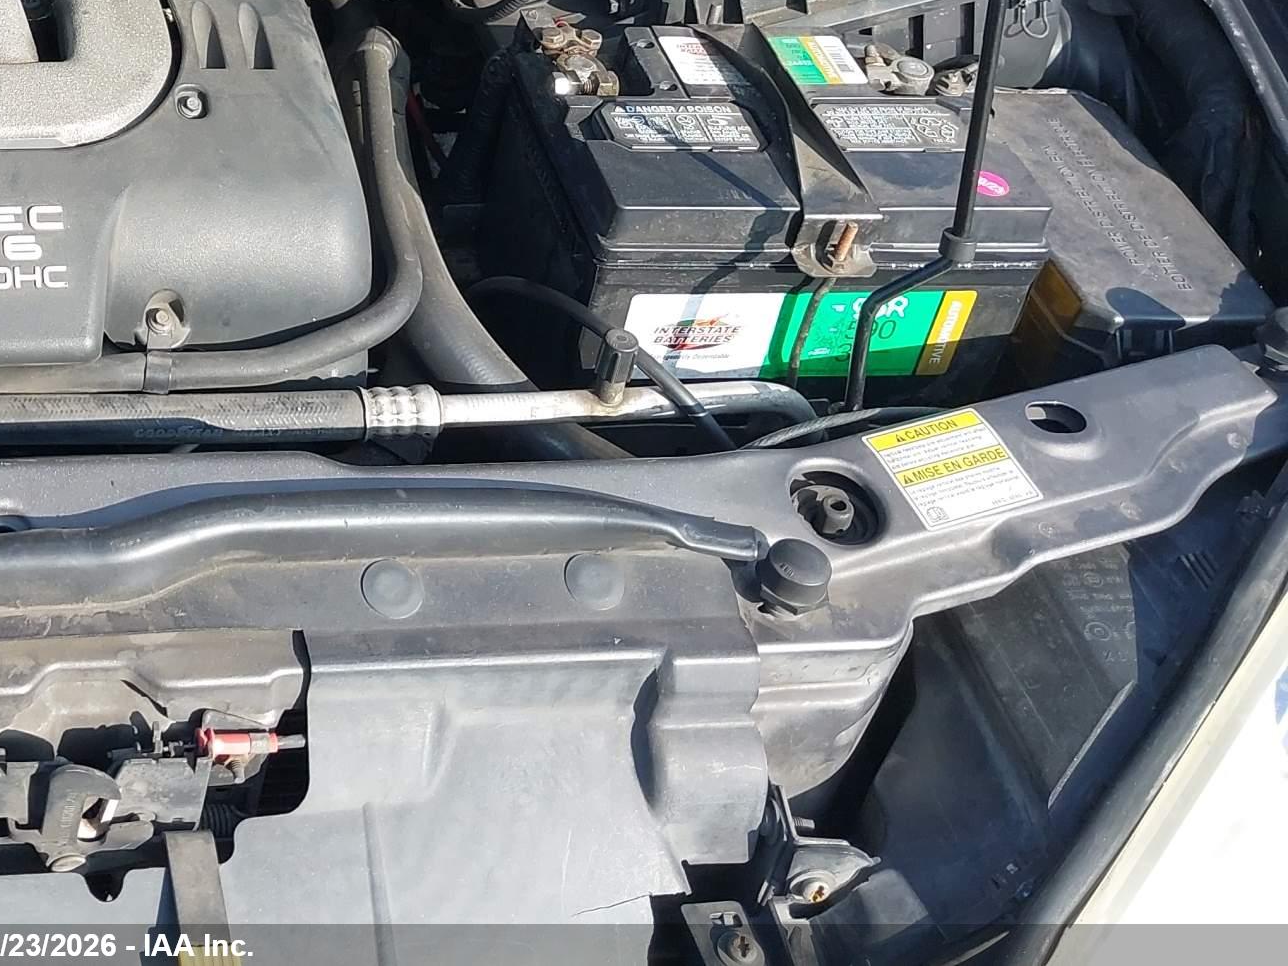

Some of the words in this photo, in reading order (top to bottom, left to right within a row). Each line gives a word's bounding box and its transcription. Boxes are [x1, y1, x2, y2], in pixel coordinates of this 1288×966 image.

[626, 105, 676, 114] DANGER
[686, 105, 732, 114] POISON
[653, 325, 743, 335] INTERSTATE
[653, 335, 734, 345] BATTERIES
[903, 419, 958, 441] CAUTION
[913, 464, 941, 483] MISE
[945, 460, 962, 473] EN
[962, 447, 1006, 469] GARDE
